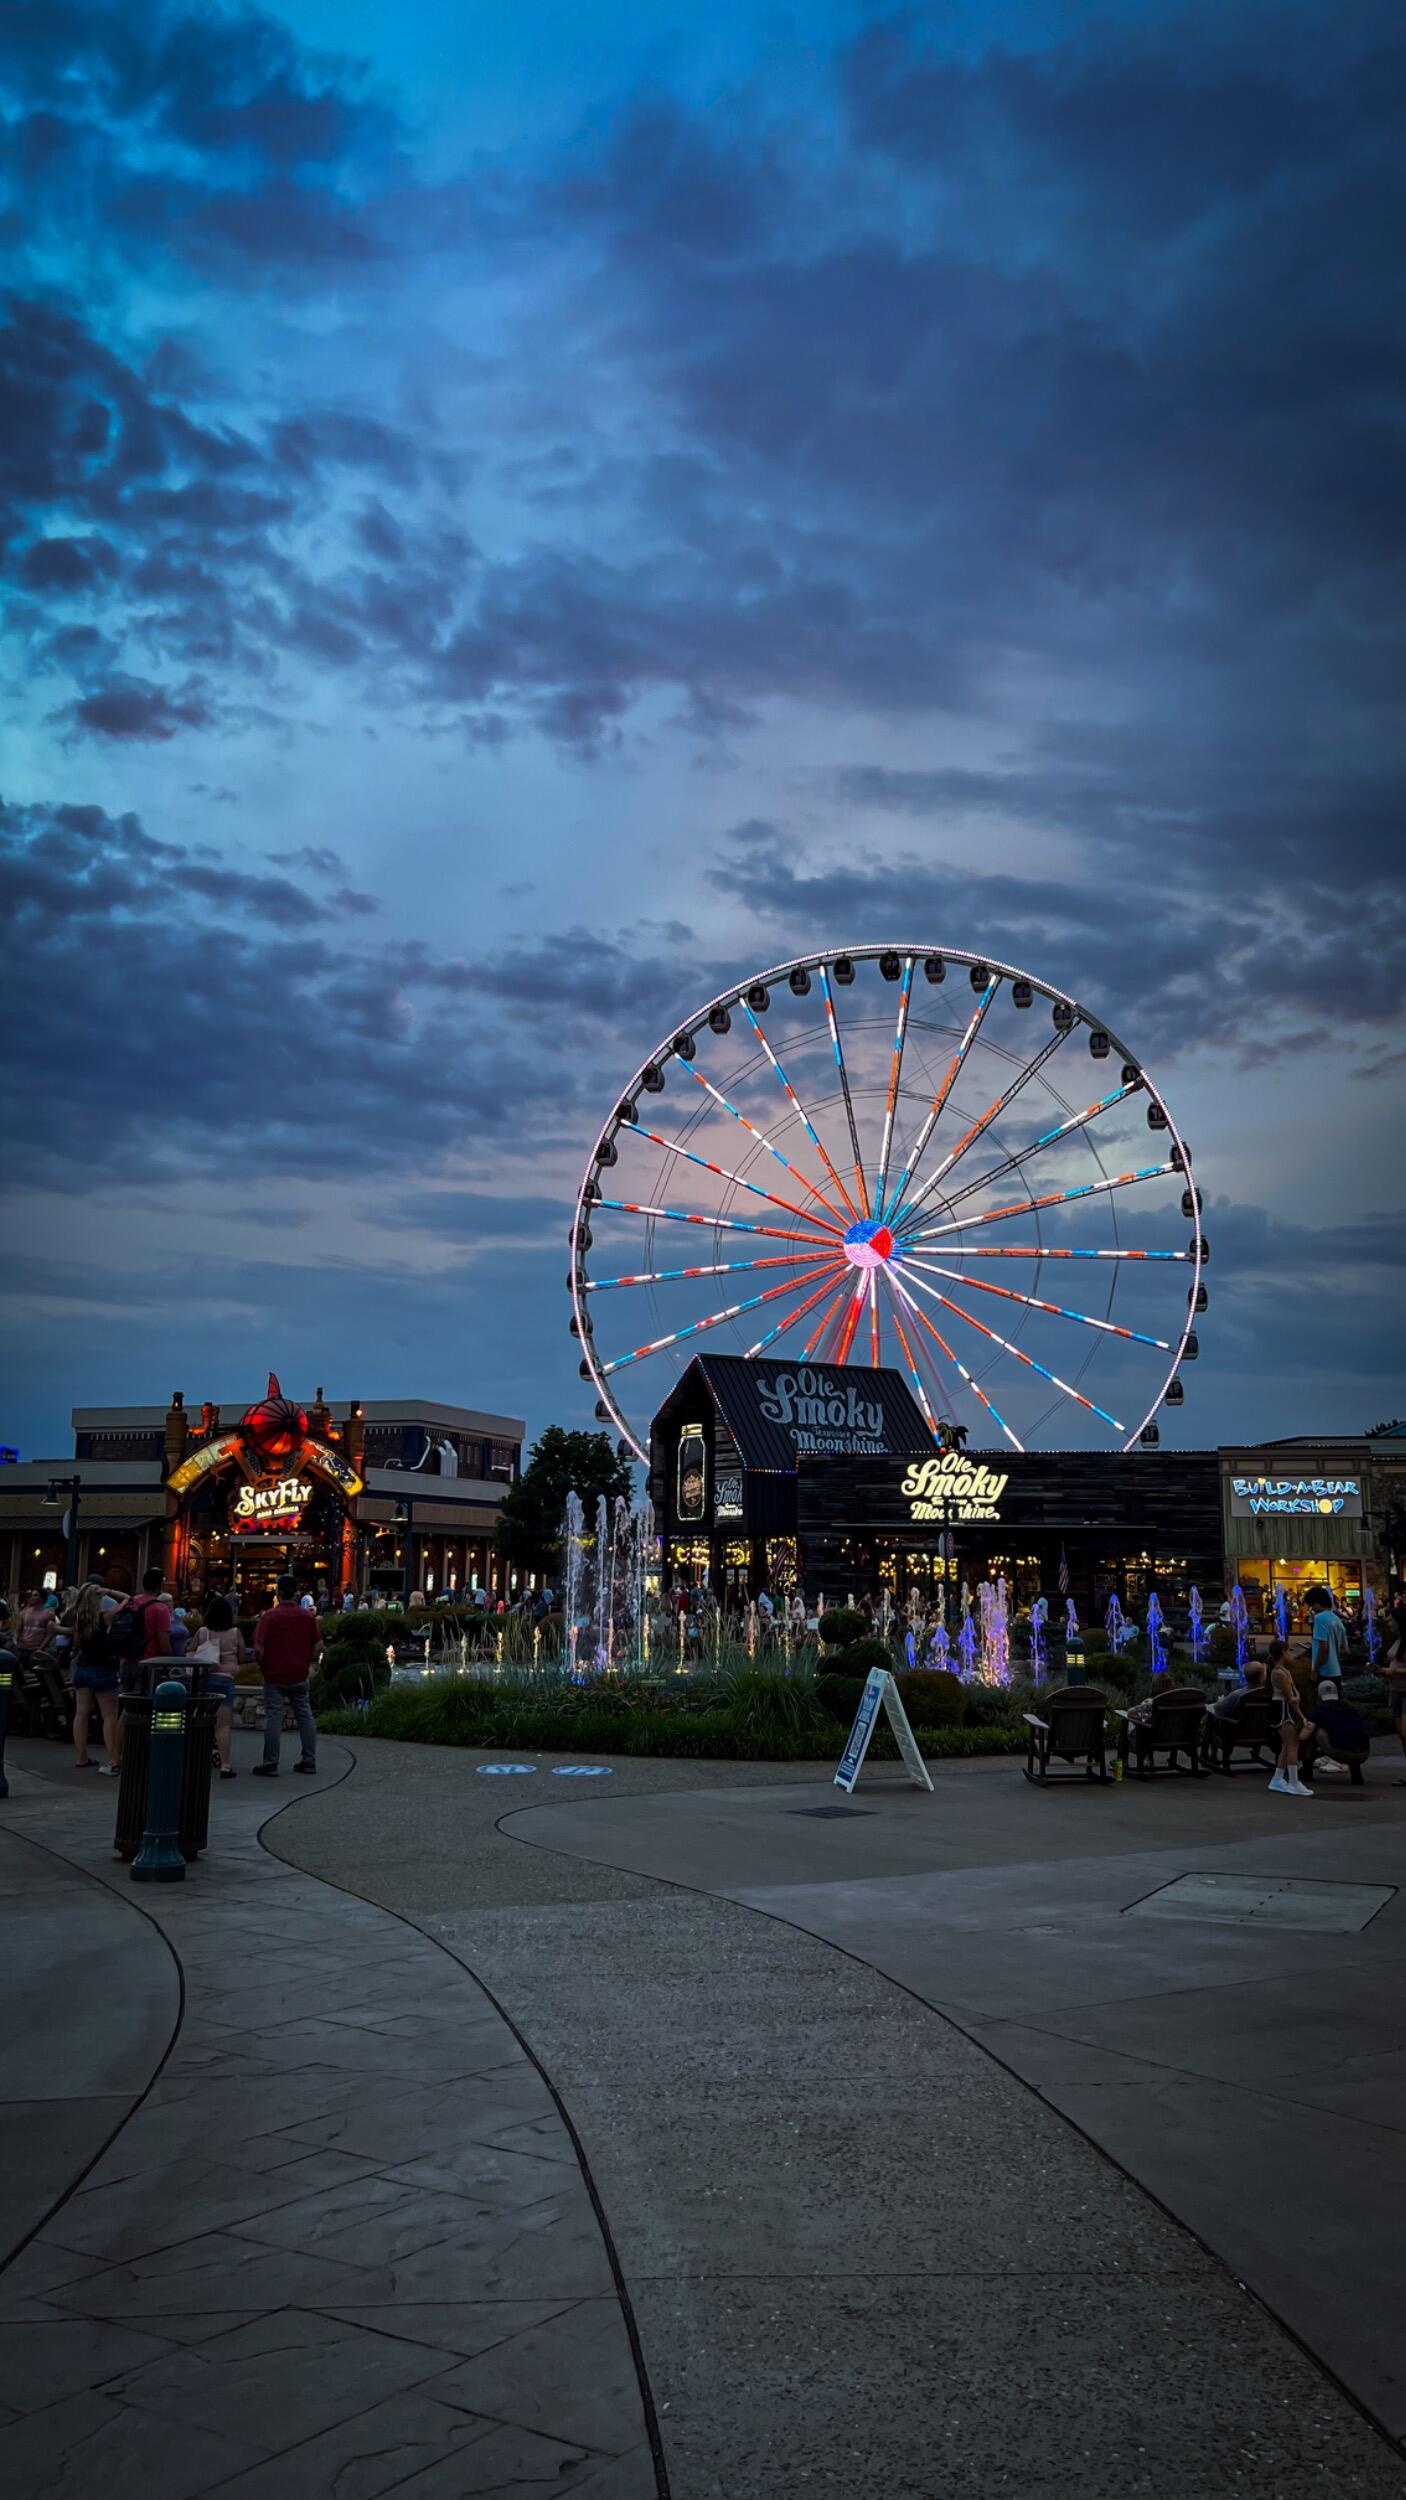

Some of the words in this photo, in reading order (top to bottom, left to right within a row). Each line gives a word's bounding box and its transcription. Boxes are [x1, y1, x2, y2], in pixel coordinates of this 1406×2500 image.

[797, 1367, 846, 1400] Ole
[756, 1373, 884, 1437] Smoky
[790, 1428, 889, 1453] Moonshine
[940, 1451, 977, 1475] Ole
[900, 1458, 1009, 1504] Smoky
[1249, 1497, 1345, 1515] WORKSHOP
